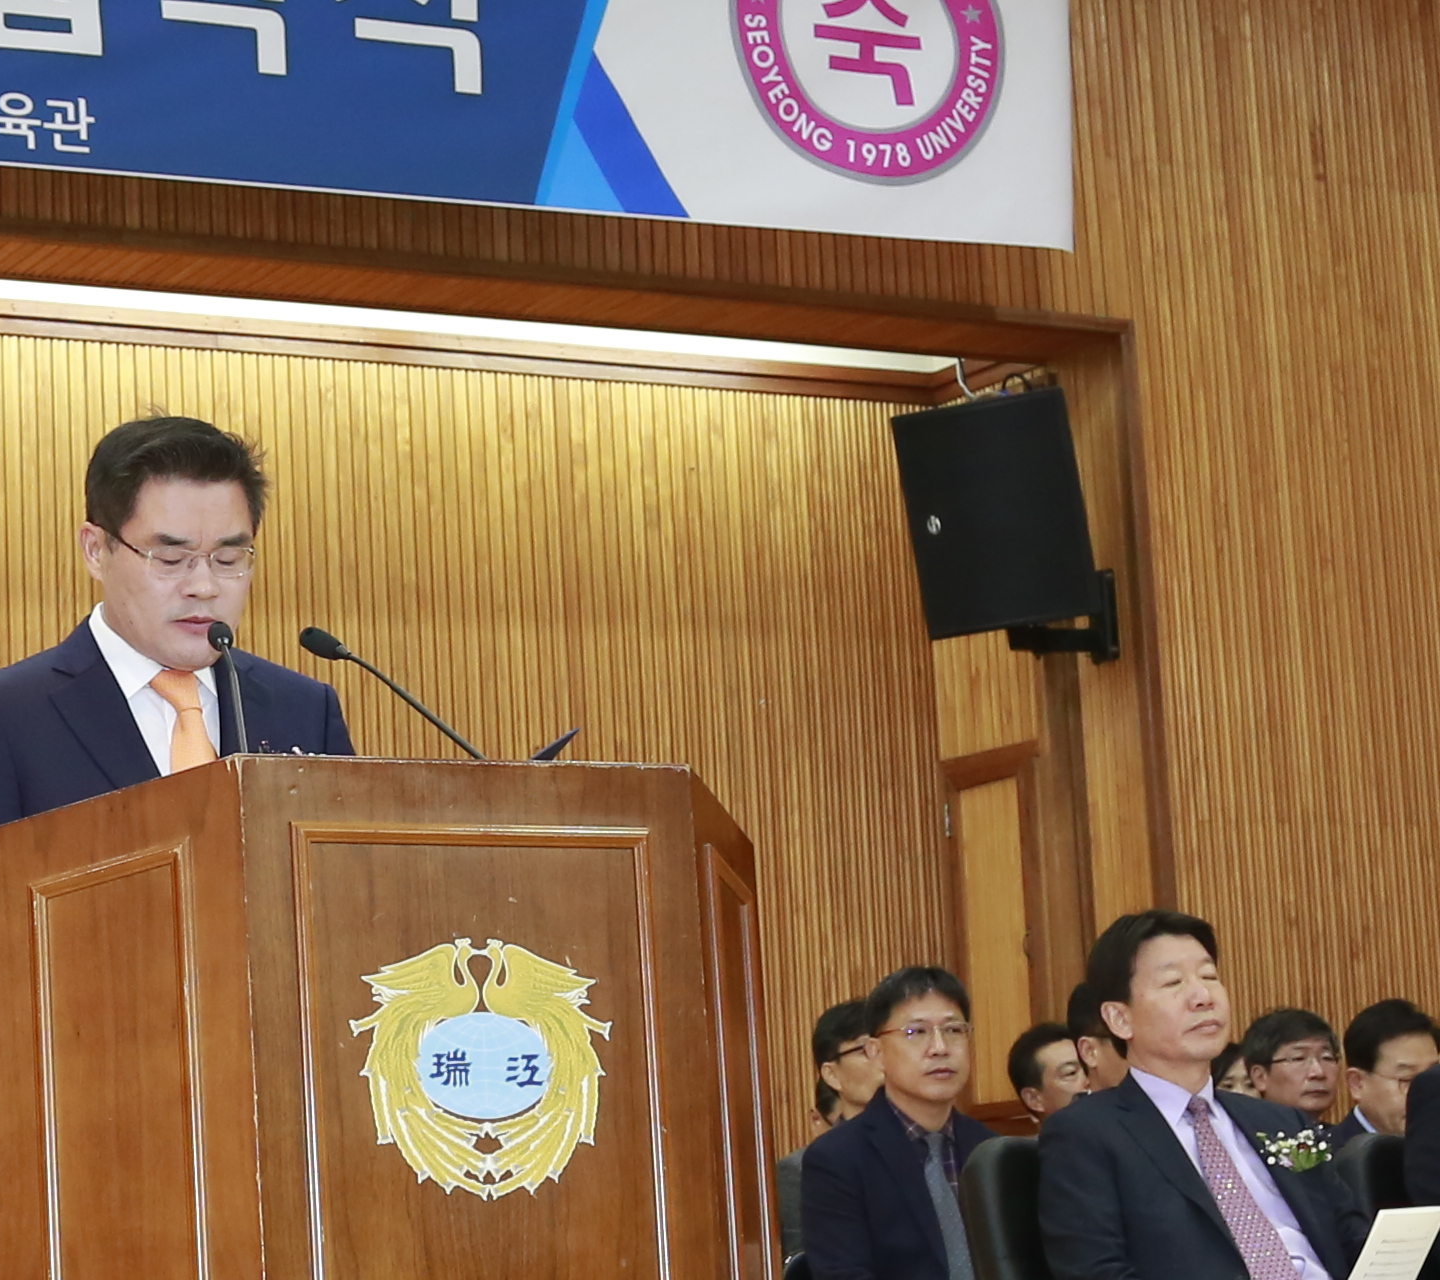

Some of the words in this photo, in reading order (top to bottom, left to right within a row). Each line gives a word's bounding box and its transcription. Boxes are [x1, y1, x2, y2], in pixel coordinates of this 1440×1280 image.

[743, 13, 834, 152] SEOYEONG
[846, 138, 912, 168] 1978
[917, 36, 993, 161] UNIVERSITY
